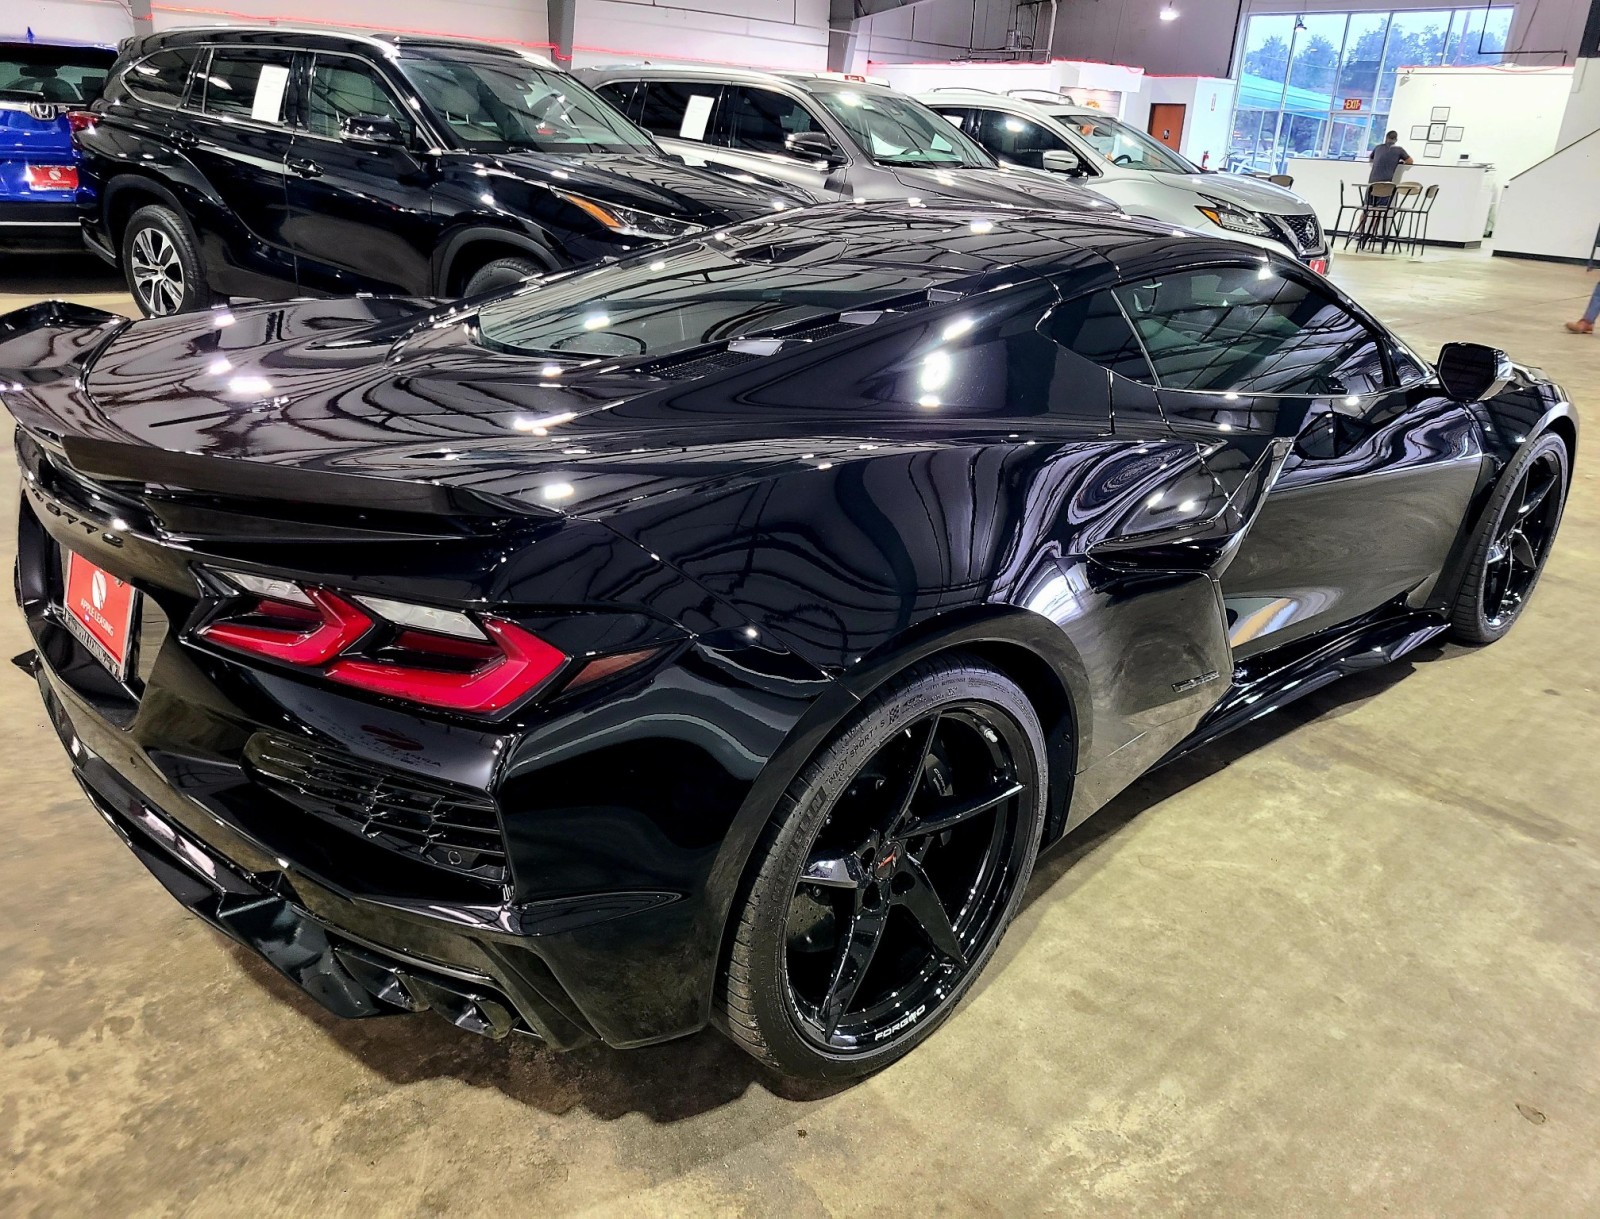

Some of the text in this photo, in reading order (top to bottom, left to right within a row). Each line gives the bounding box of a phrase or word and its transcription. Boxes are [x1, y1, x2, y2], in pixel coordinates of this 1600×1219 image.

[1345, 99, 1360, 110] EXIT
[80, 598, 114, 637] APPLE LEASING
[850, 728, 874, 758] SPORT
